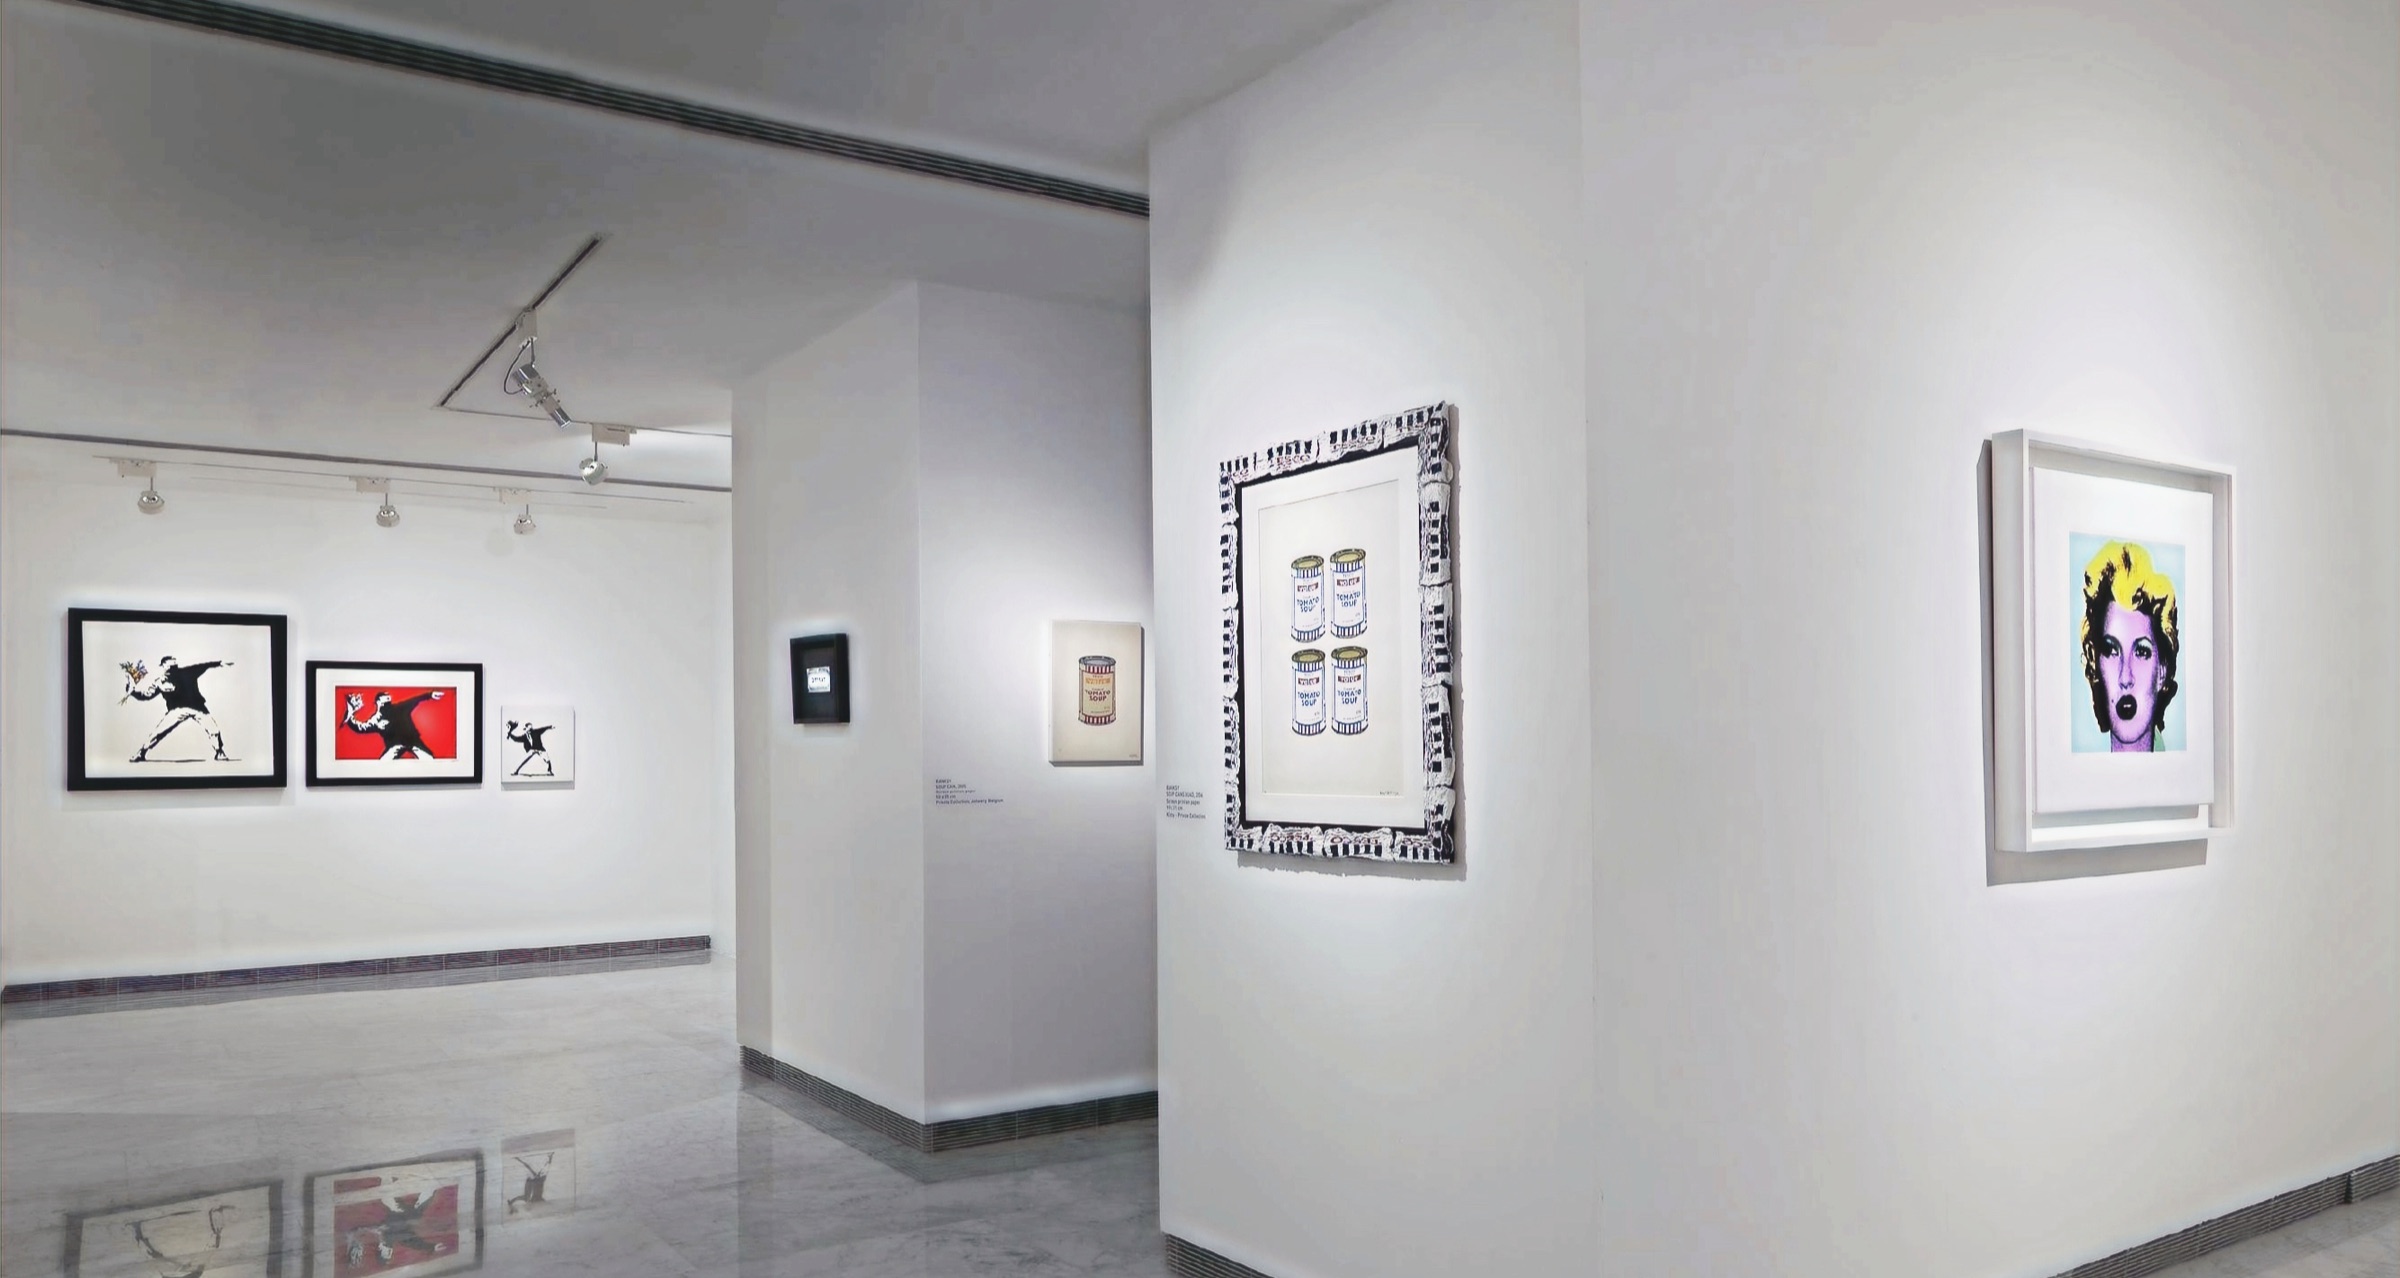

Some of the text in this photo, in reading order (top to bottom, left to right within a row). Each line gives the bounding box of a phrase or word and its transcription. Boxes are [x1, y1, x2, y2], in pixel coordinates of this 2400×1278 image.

[1336, 591, 1361, 601] TOMATO
[1297, 691, 1321, 699] TOMATO
[1337, 689, 1362, 697] TOMATO
